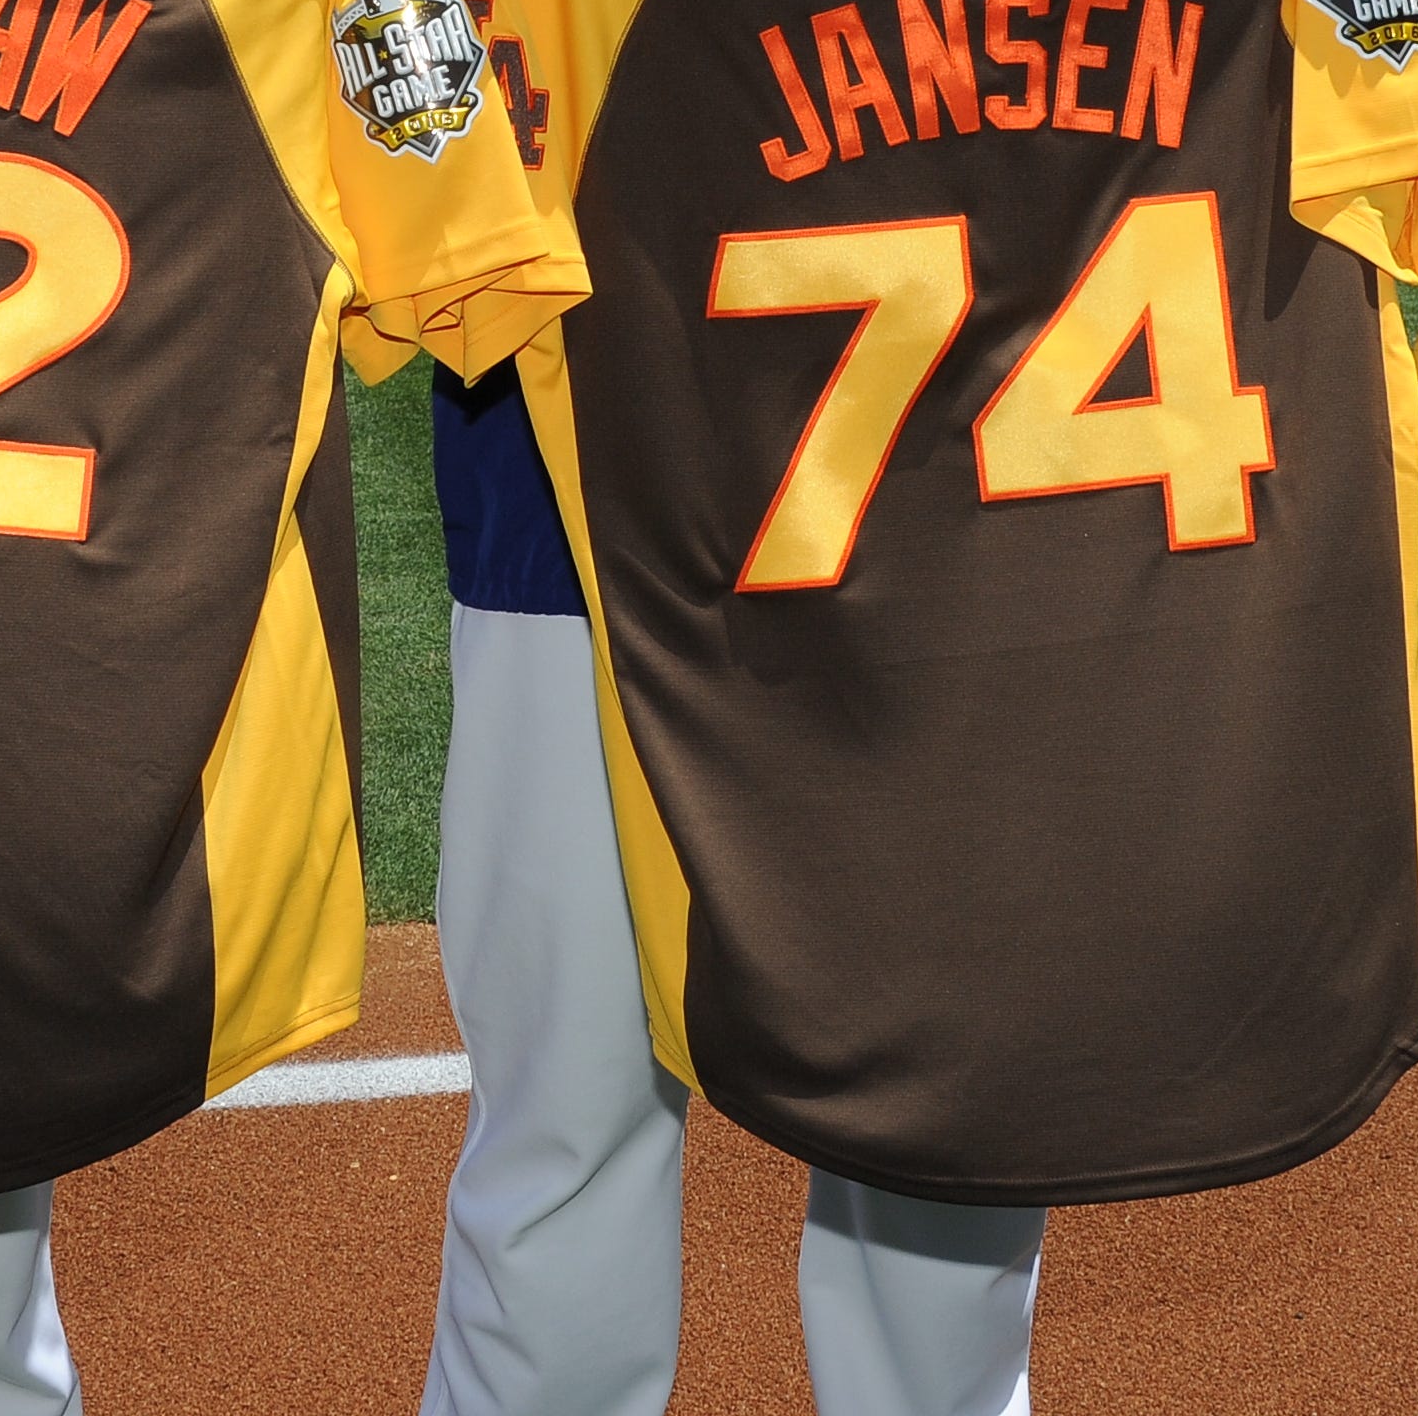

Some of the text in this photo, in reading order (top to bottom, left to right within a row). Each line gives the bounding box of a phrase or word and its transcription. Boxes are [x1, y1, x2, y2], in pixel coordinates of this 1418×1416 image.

[336, 3, 474, 100] ALL STAR
[373, 65, 456, 119] GAME
[706, 190, 1276, 594] 74
